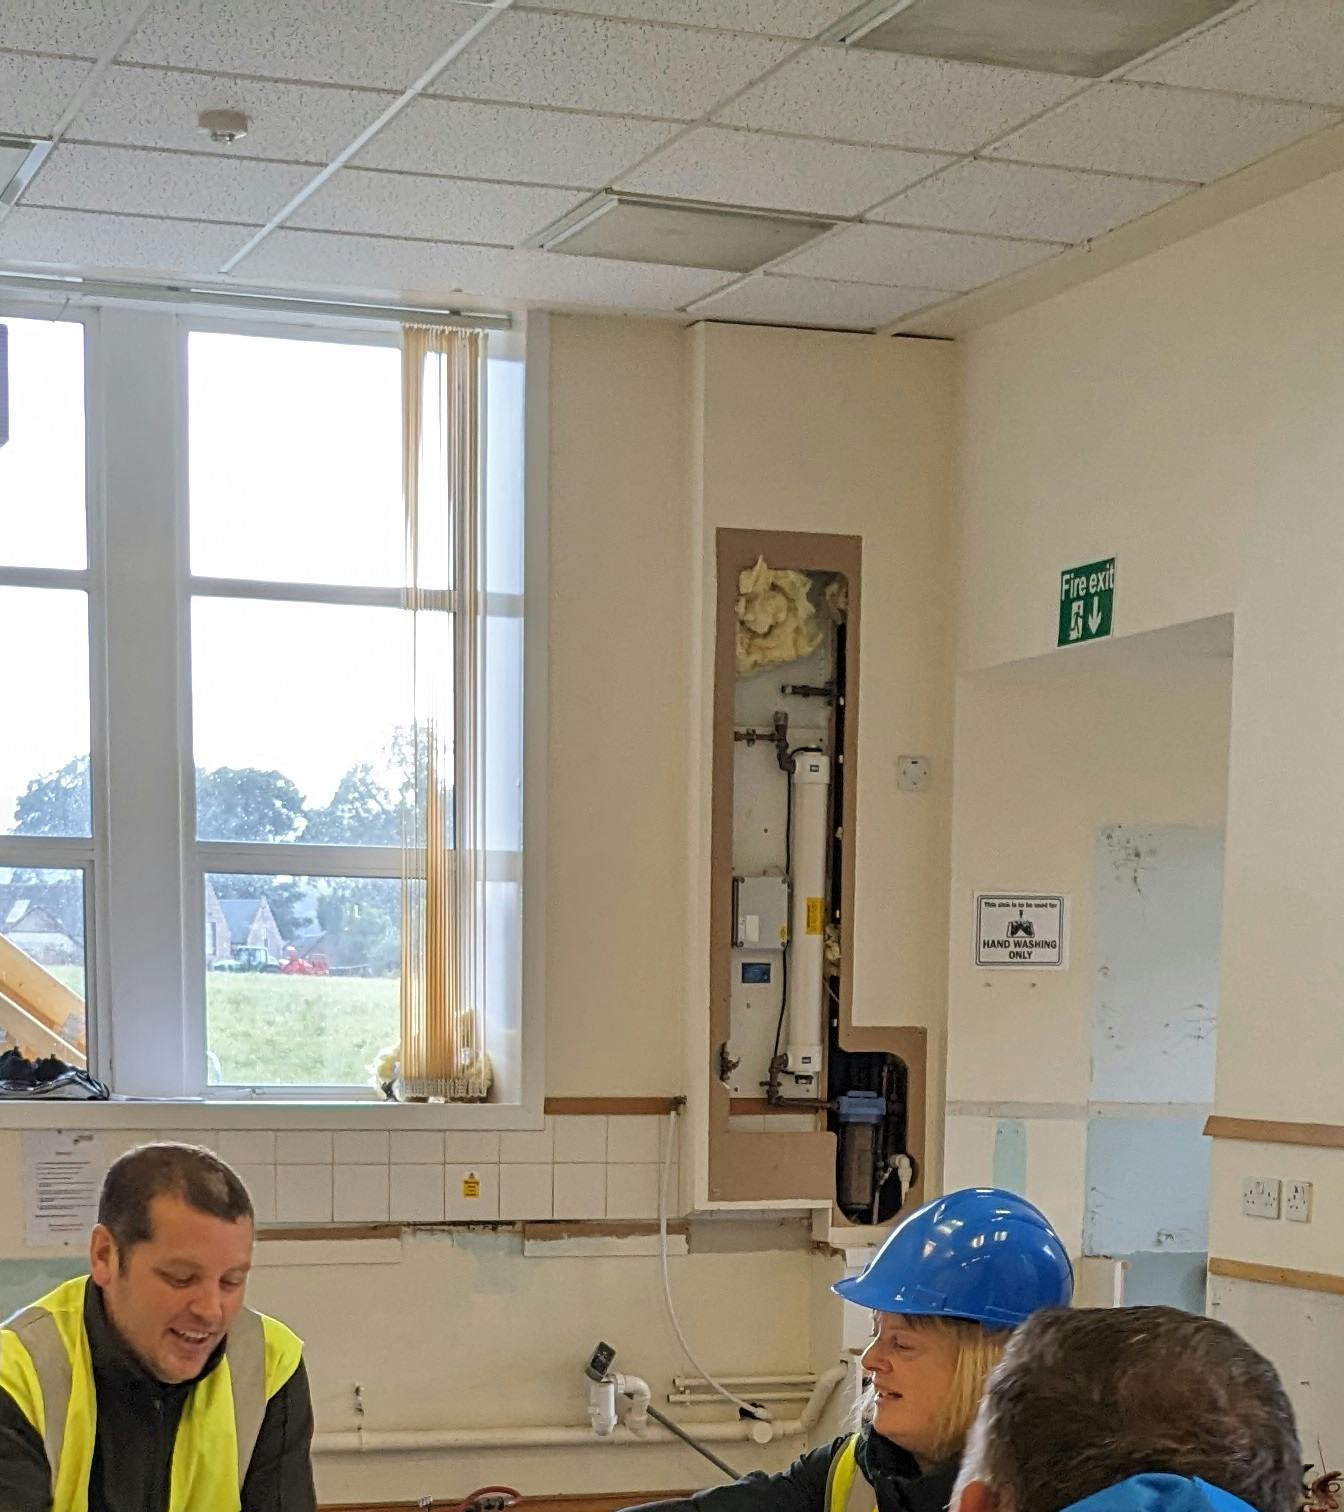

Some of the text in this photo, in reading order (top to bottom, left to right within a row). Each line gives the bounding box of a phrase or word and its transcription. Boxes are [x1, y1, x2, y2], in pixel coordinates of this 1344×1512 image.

[1061, 563, 1114, 601] Fire exit
[982, 939, 1057, 949] HAND WASHING
[1008, 951, 1033, 959] ONLY
